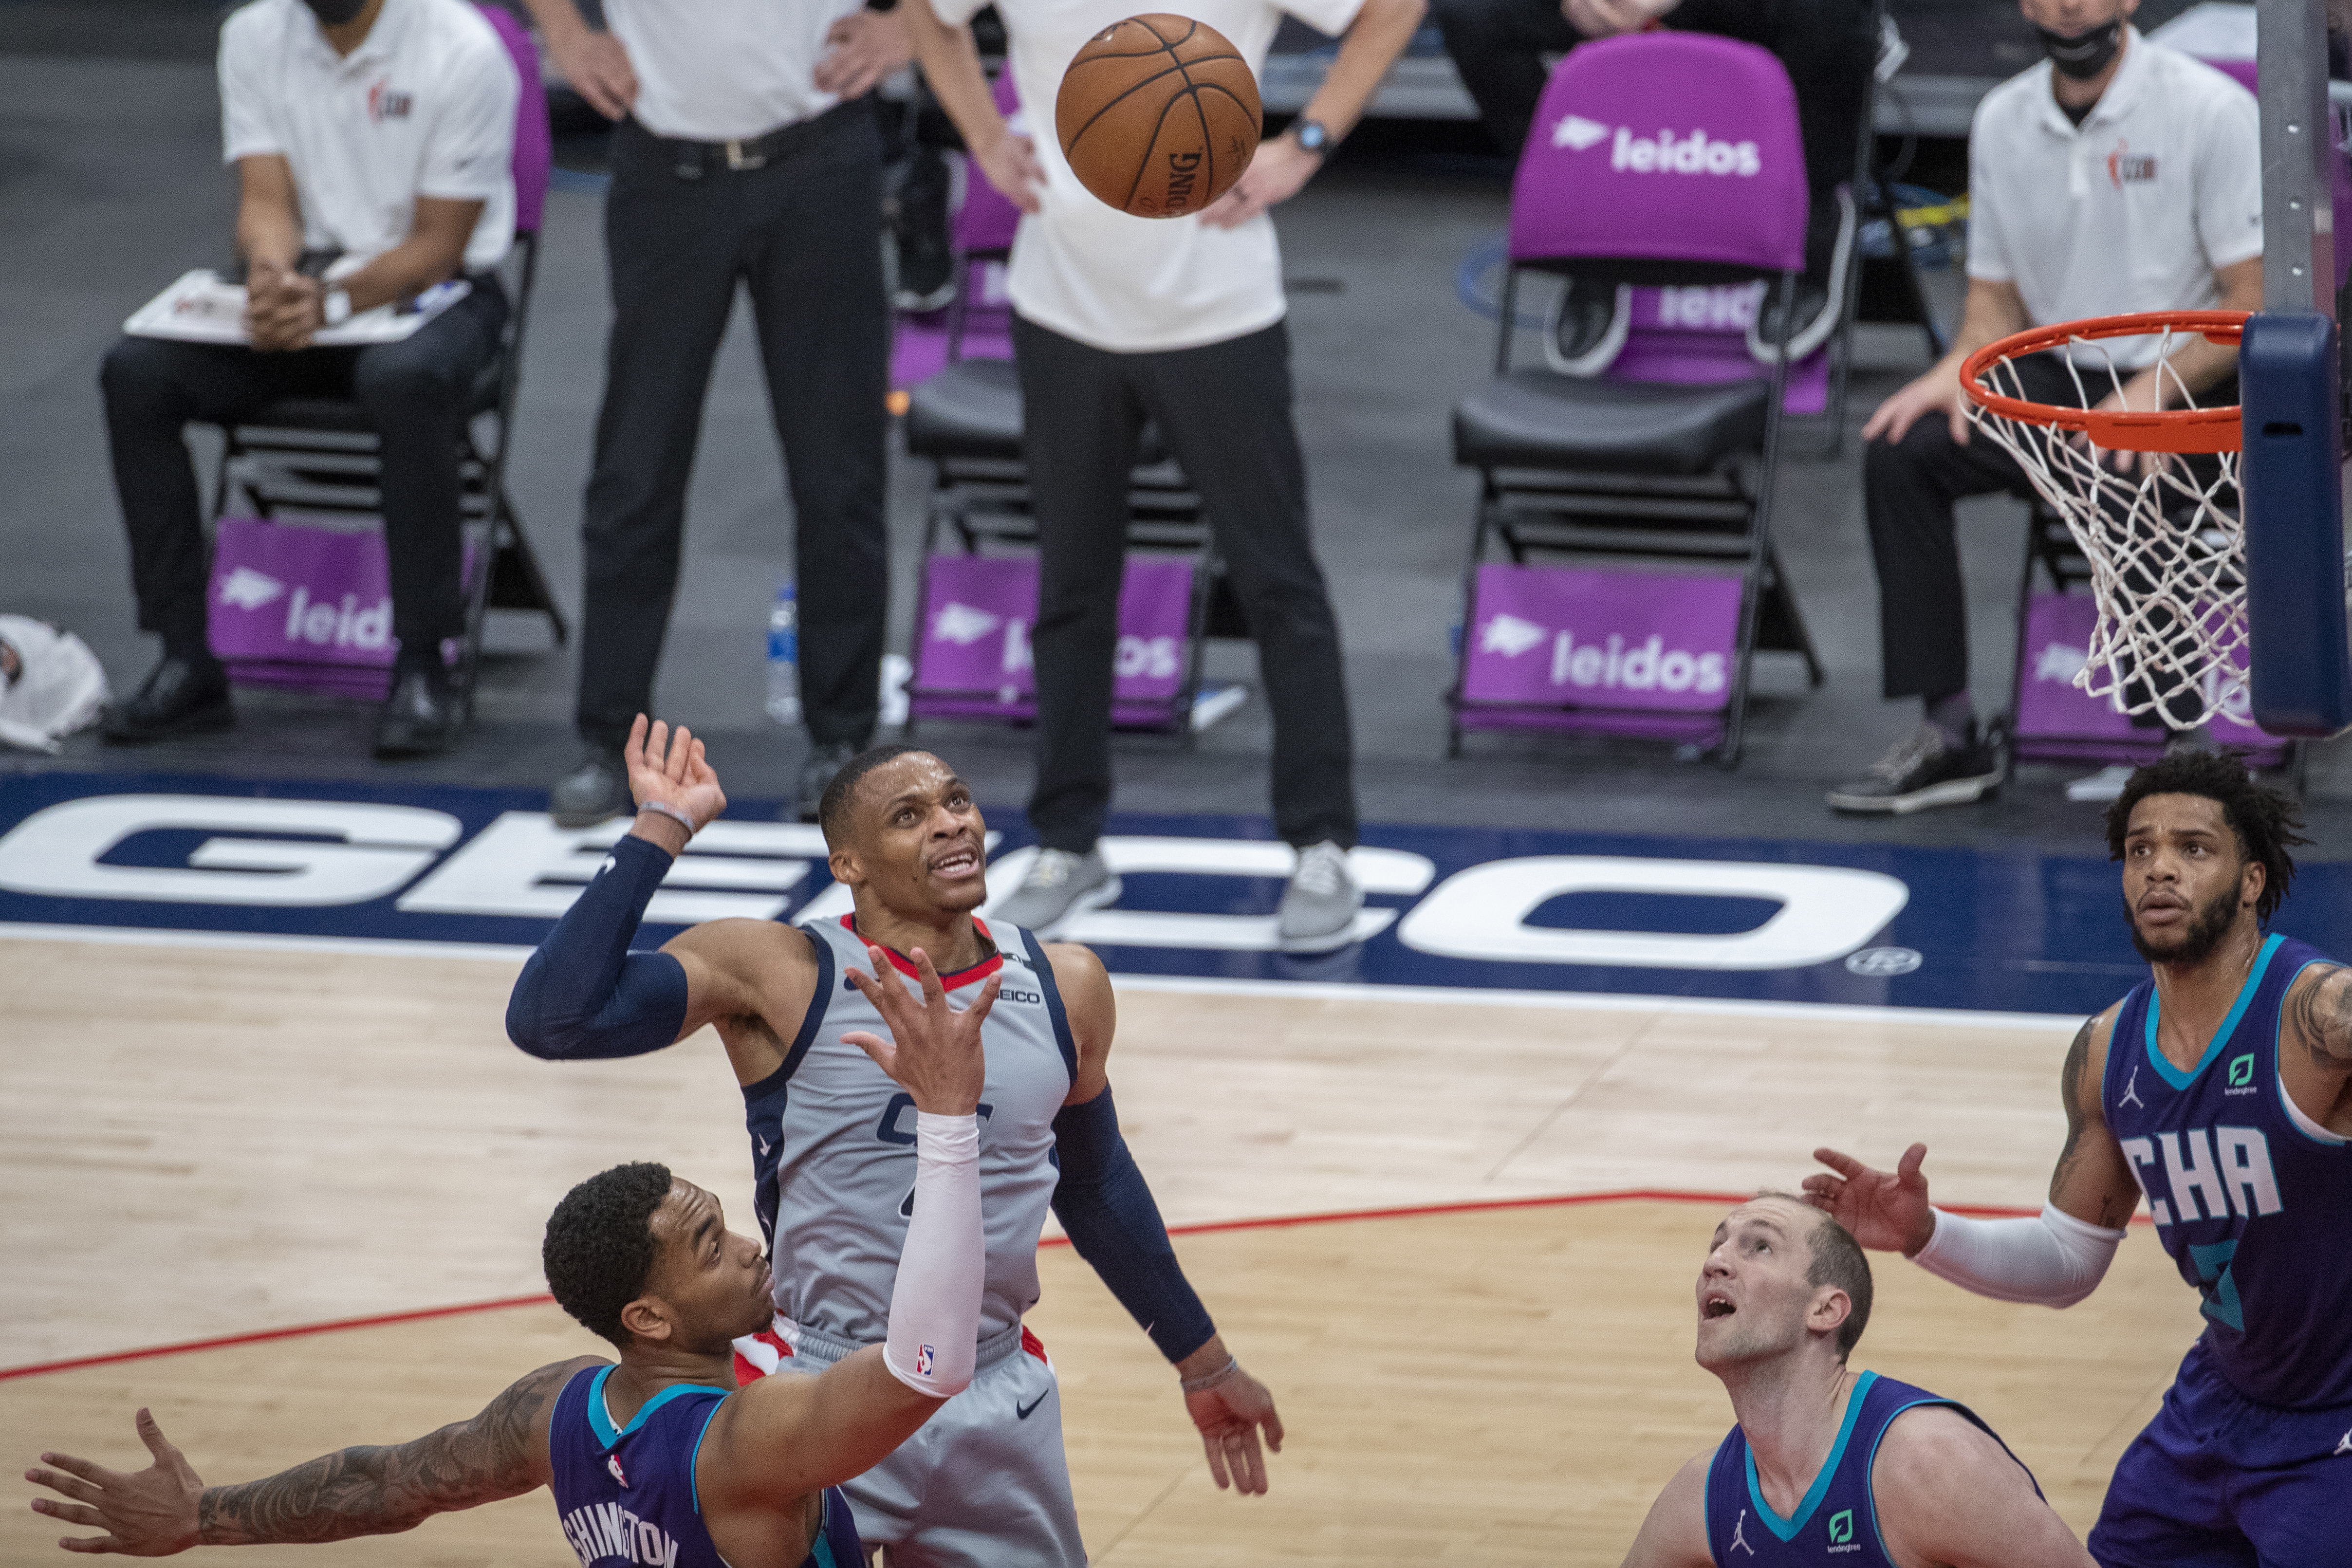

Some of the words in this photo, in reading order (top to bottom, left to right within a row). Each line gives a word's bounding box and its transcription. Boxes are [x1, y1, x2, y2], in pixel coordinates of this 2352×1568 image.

[1166, 153, 1202, 208] DING
[1611, 126, 1760, 177] leidos
[286, 587, 393, 649] leid
[1551, 630, 1725, 693] leidos
[0, 793, 1910, 971] GECO
[996, 989, 1040, 1004] EICO
[2119, 1125, 2284, 1226] CHA
[563, 1501, 679, 1568] SHINGTON
